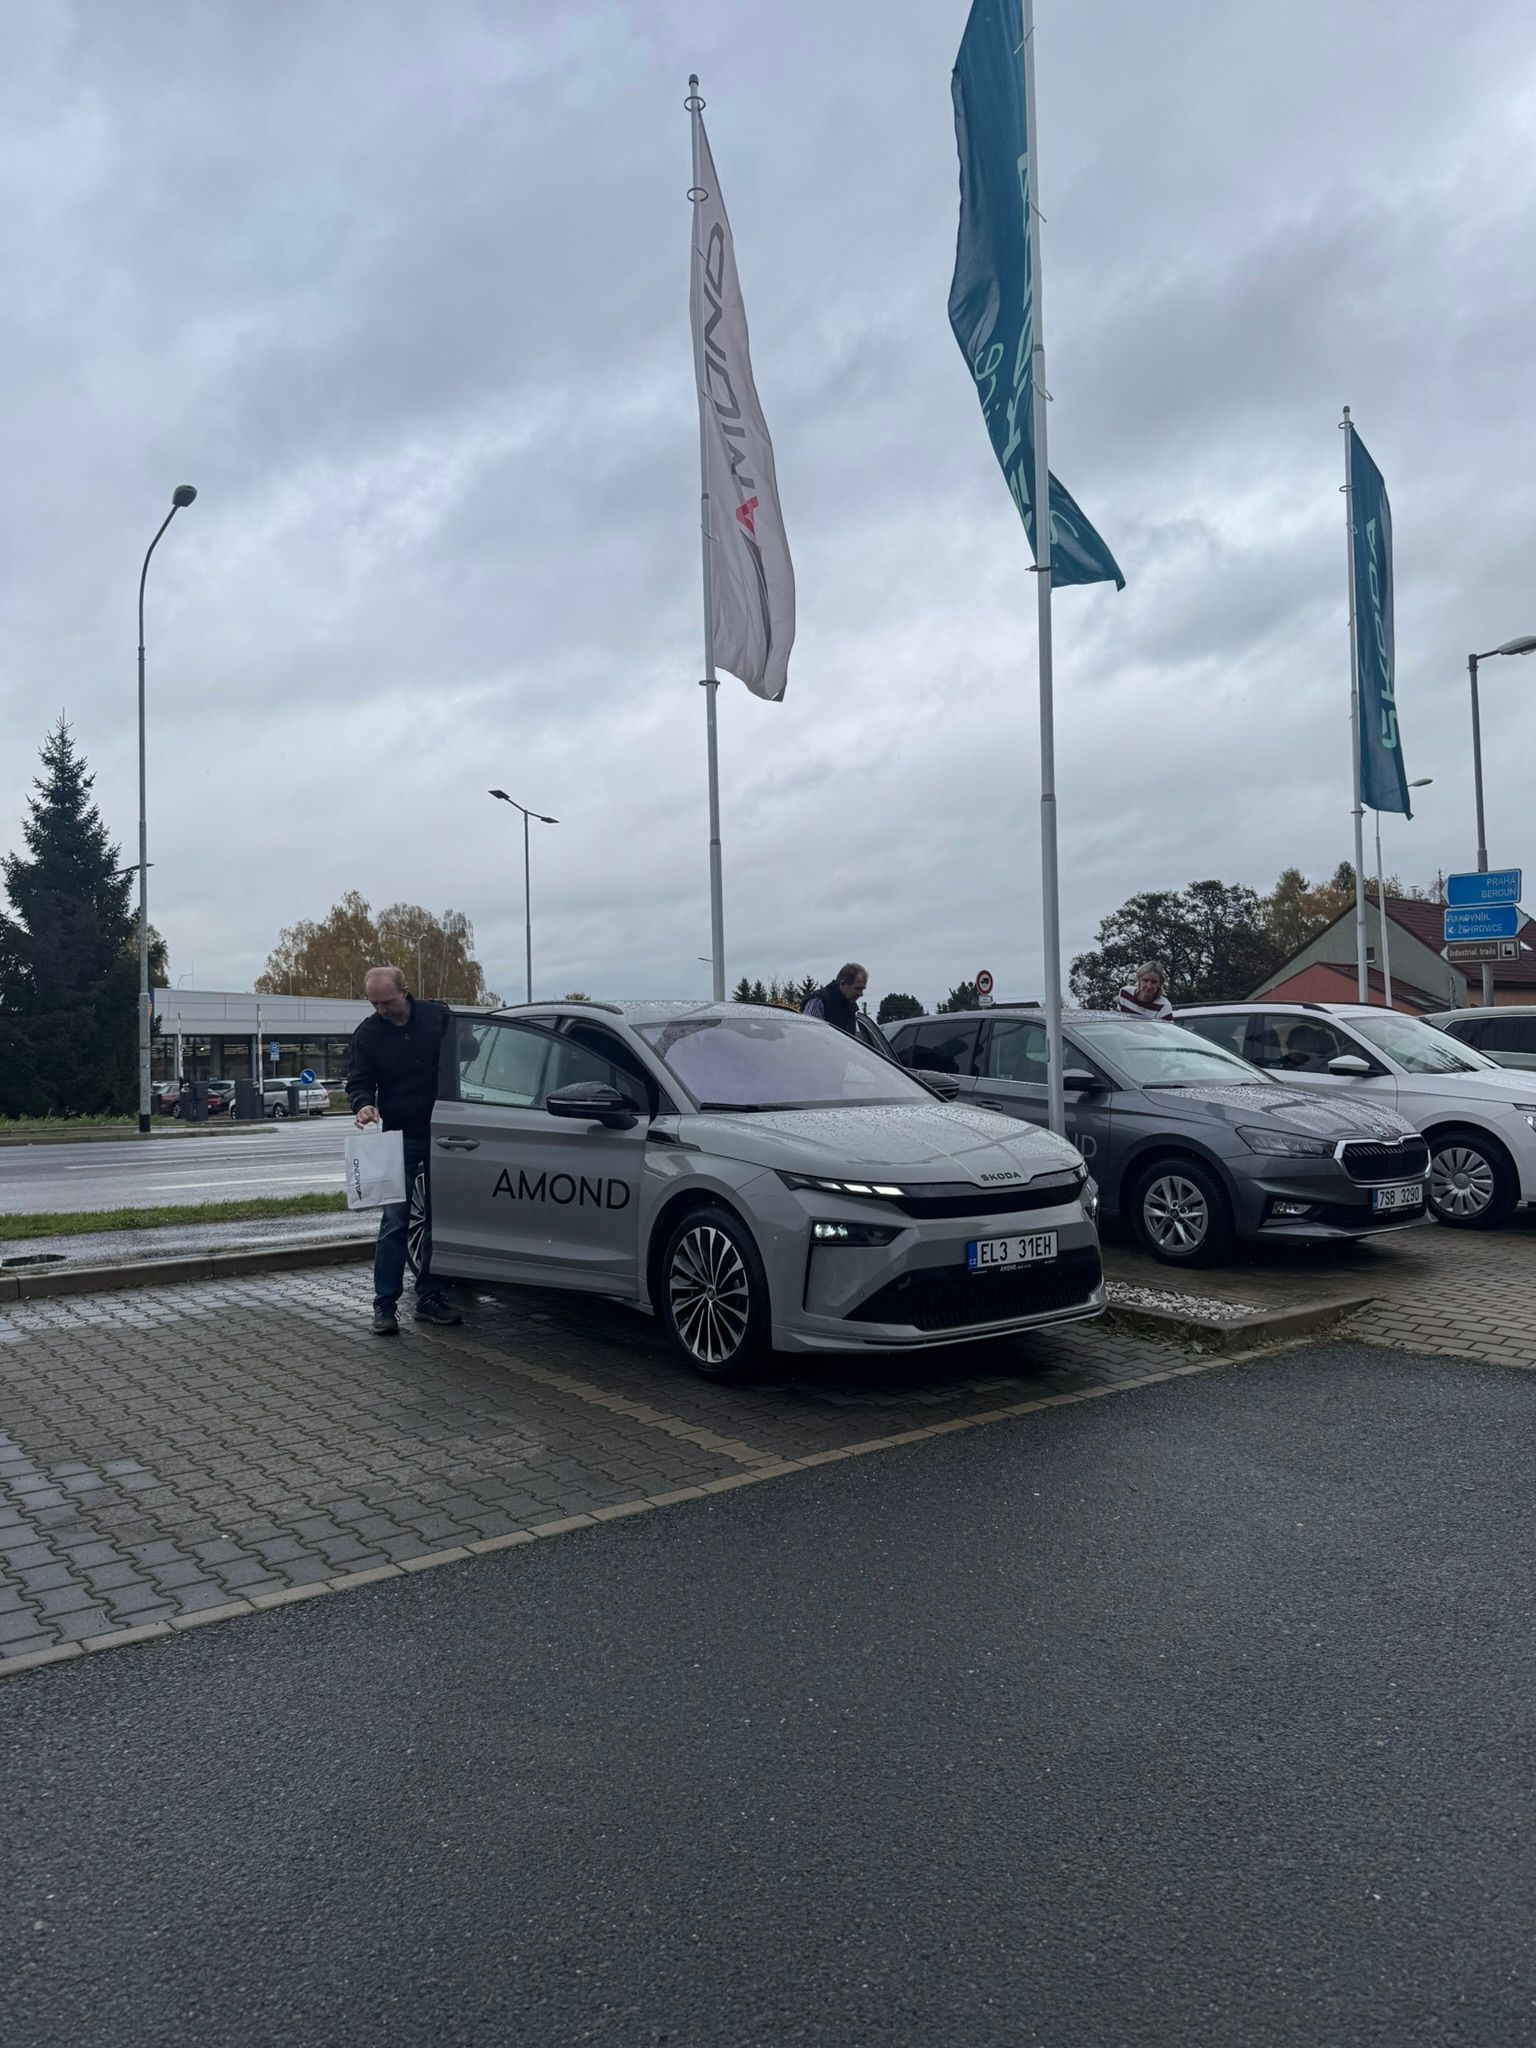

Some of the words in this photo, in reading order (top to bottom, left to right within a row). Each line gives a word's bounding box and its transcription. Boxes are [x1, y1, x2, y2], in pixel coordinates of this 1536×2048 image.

[1487, 877, 1516, 886] PRAHA
[1481, 888, 1516, 898] BEROUN
[1450, 948, 1477, 956] Industrial
[1480, 946, 1496, 955] trails
[491, 1168, 631, 1210] AMOND
[1380, 1190, 1395, 1206] 7SB
[1401, 1186, 1419, 1203] 3290
[981, 1241, 1007, 1263] EL3
[1019, 1236, 1051, 1258] 31EH
